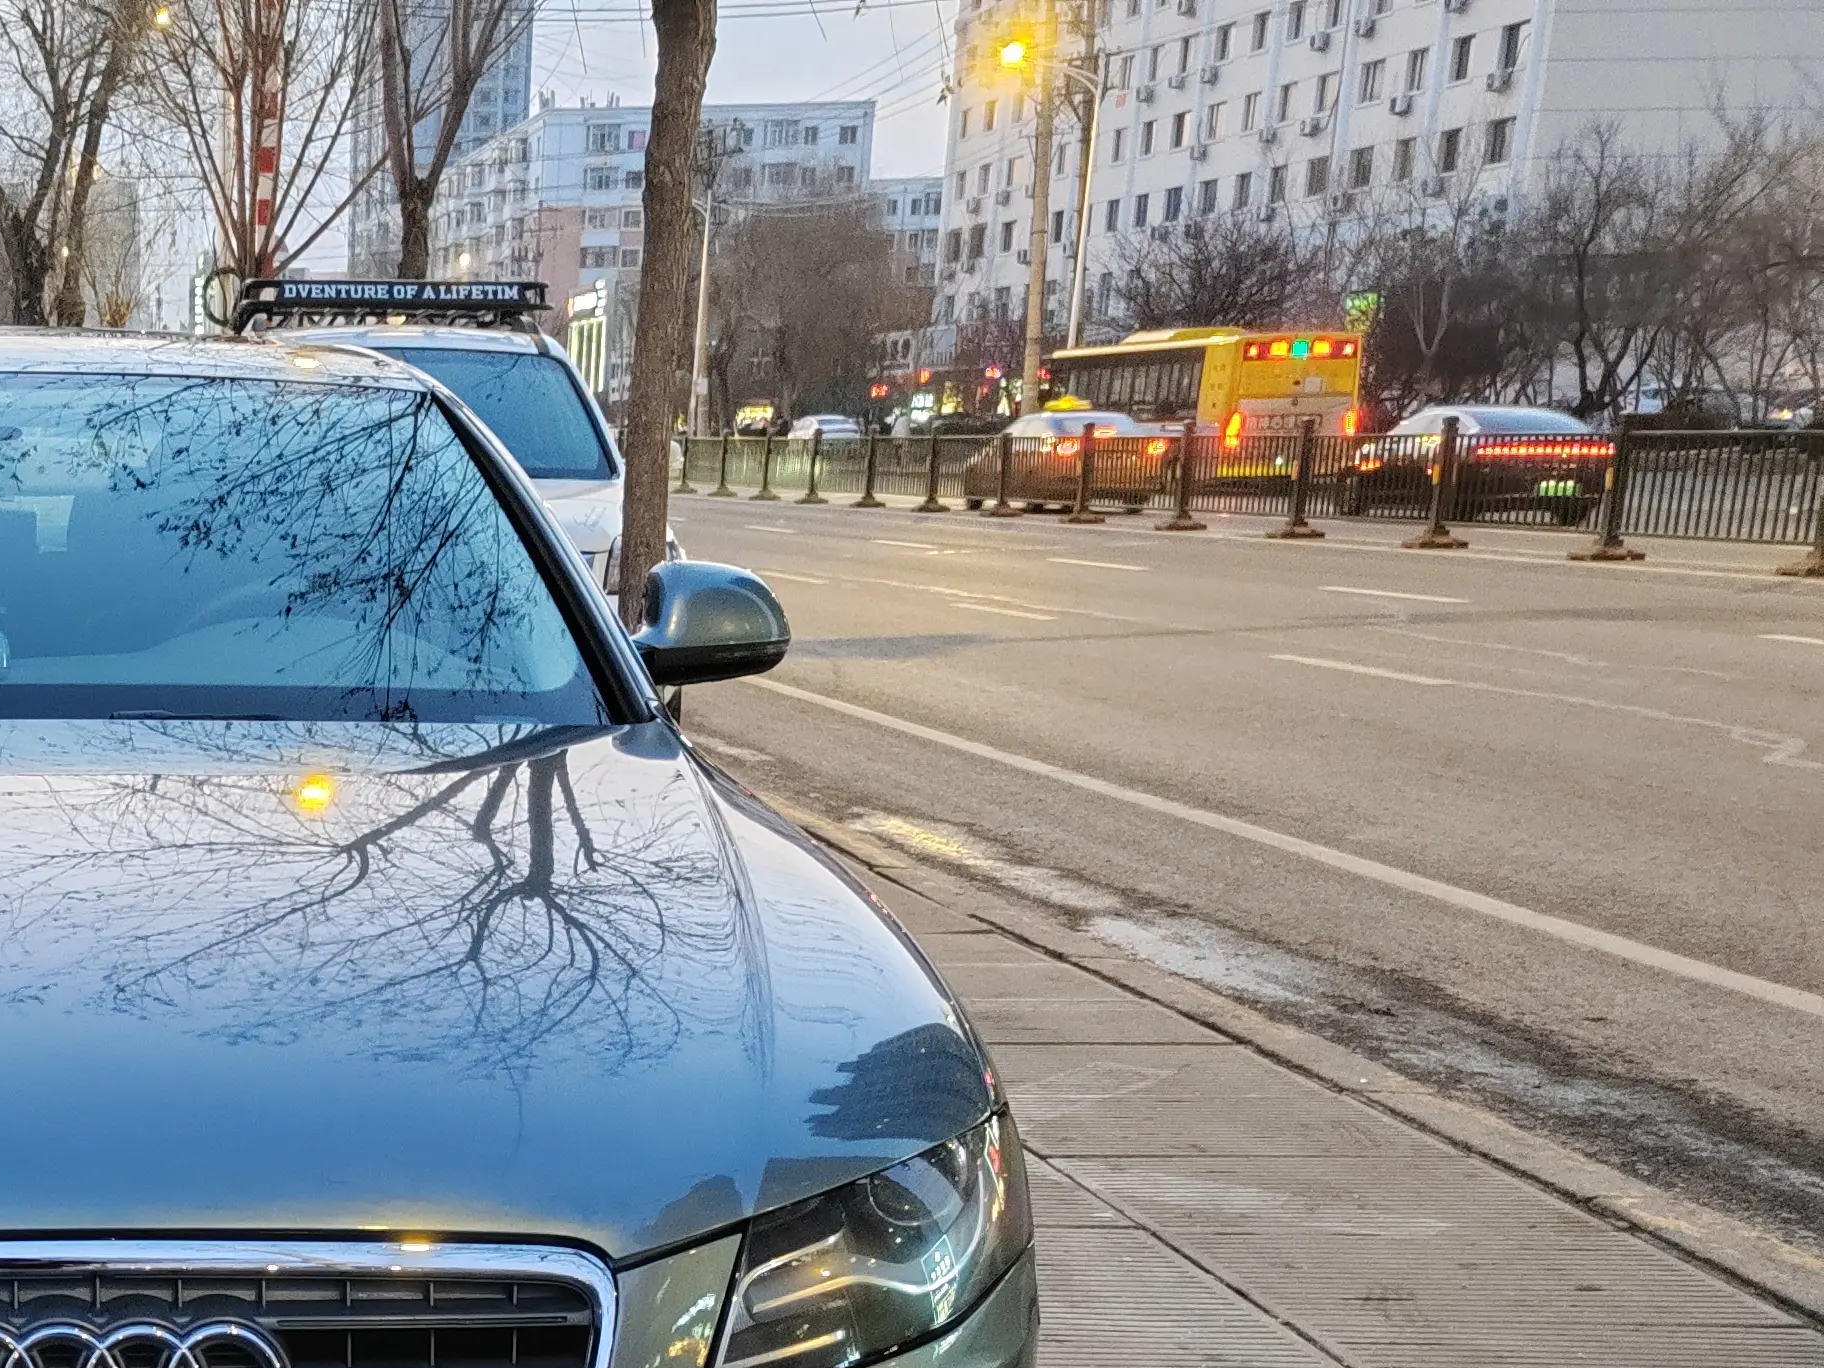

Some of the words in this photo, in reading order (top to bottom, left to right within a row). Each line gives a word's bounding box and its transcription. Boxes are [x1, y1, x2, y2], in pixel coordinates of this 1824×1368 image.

[283, 284, 389, 299] DVENTURE
[393, 285, 418, 299] OF
[422, 285, 436, 299] A
[439, 285, 519, 300] LIFETIM
